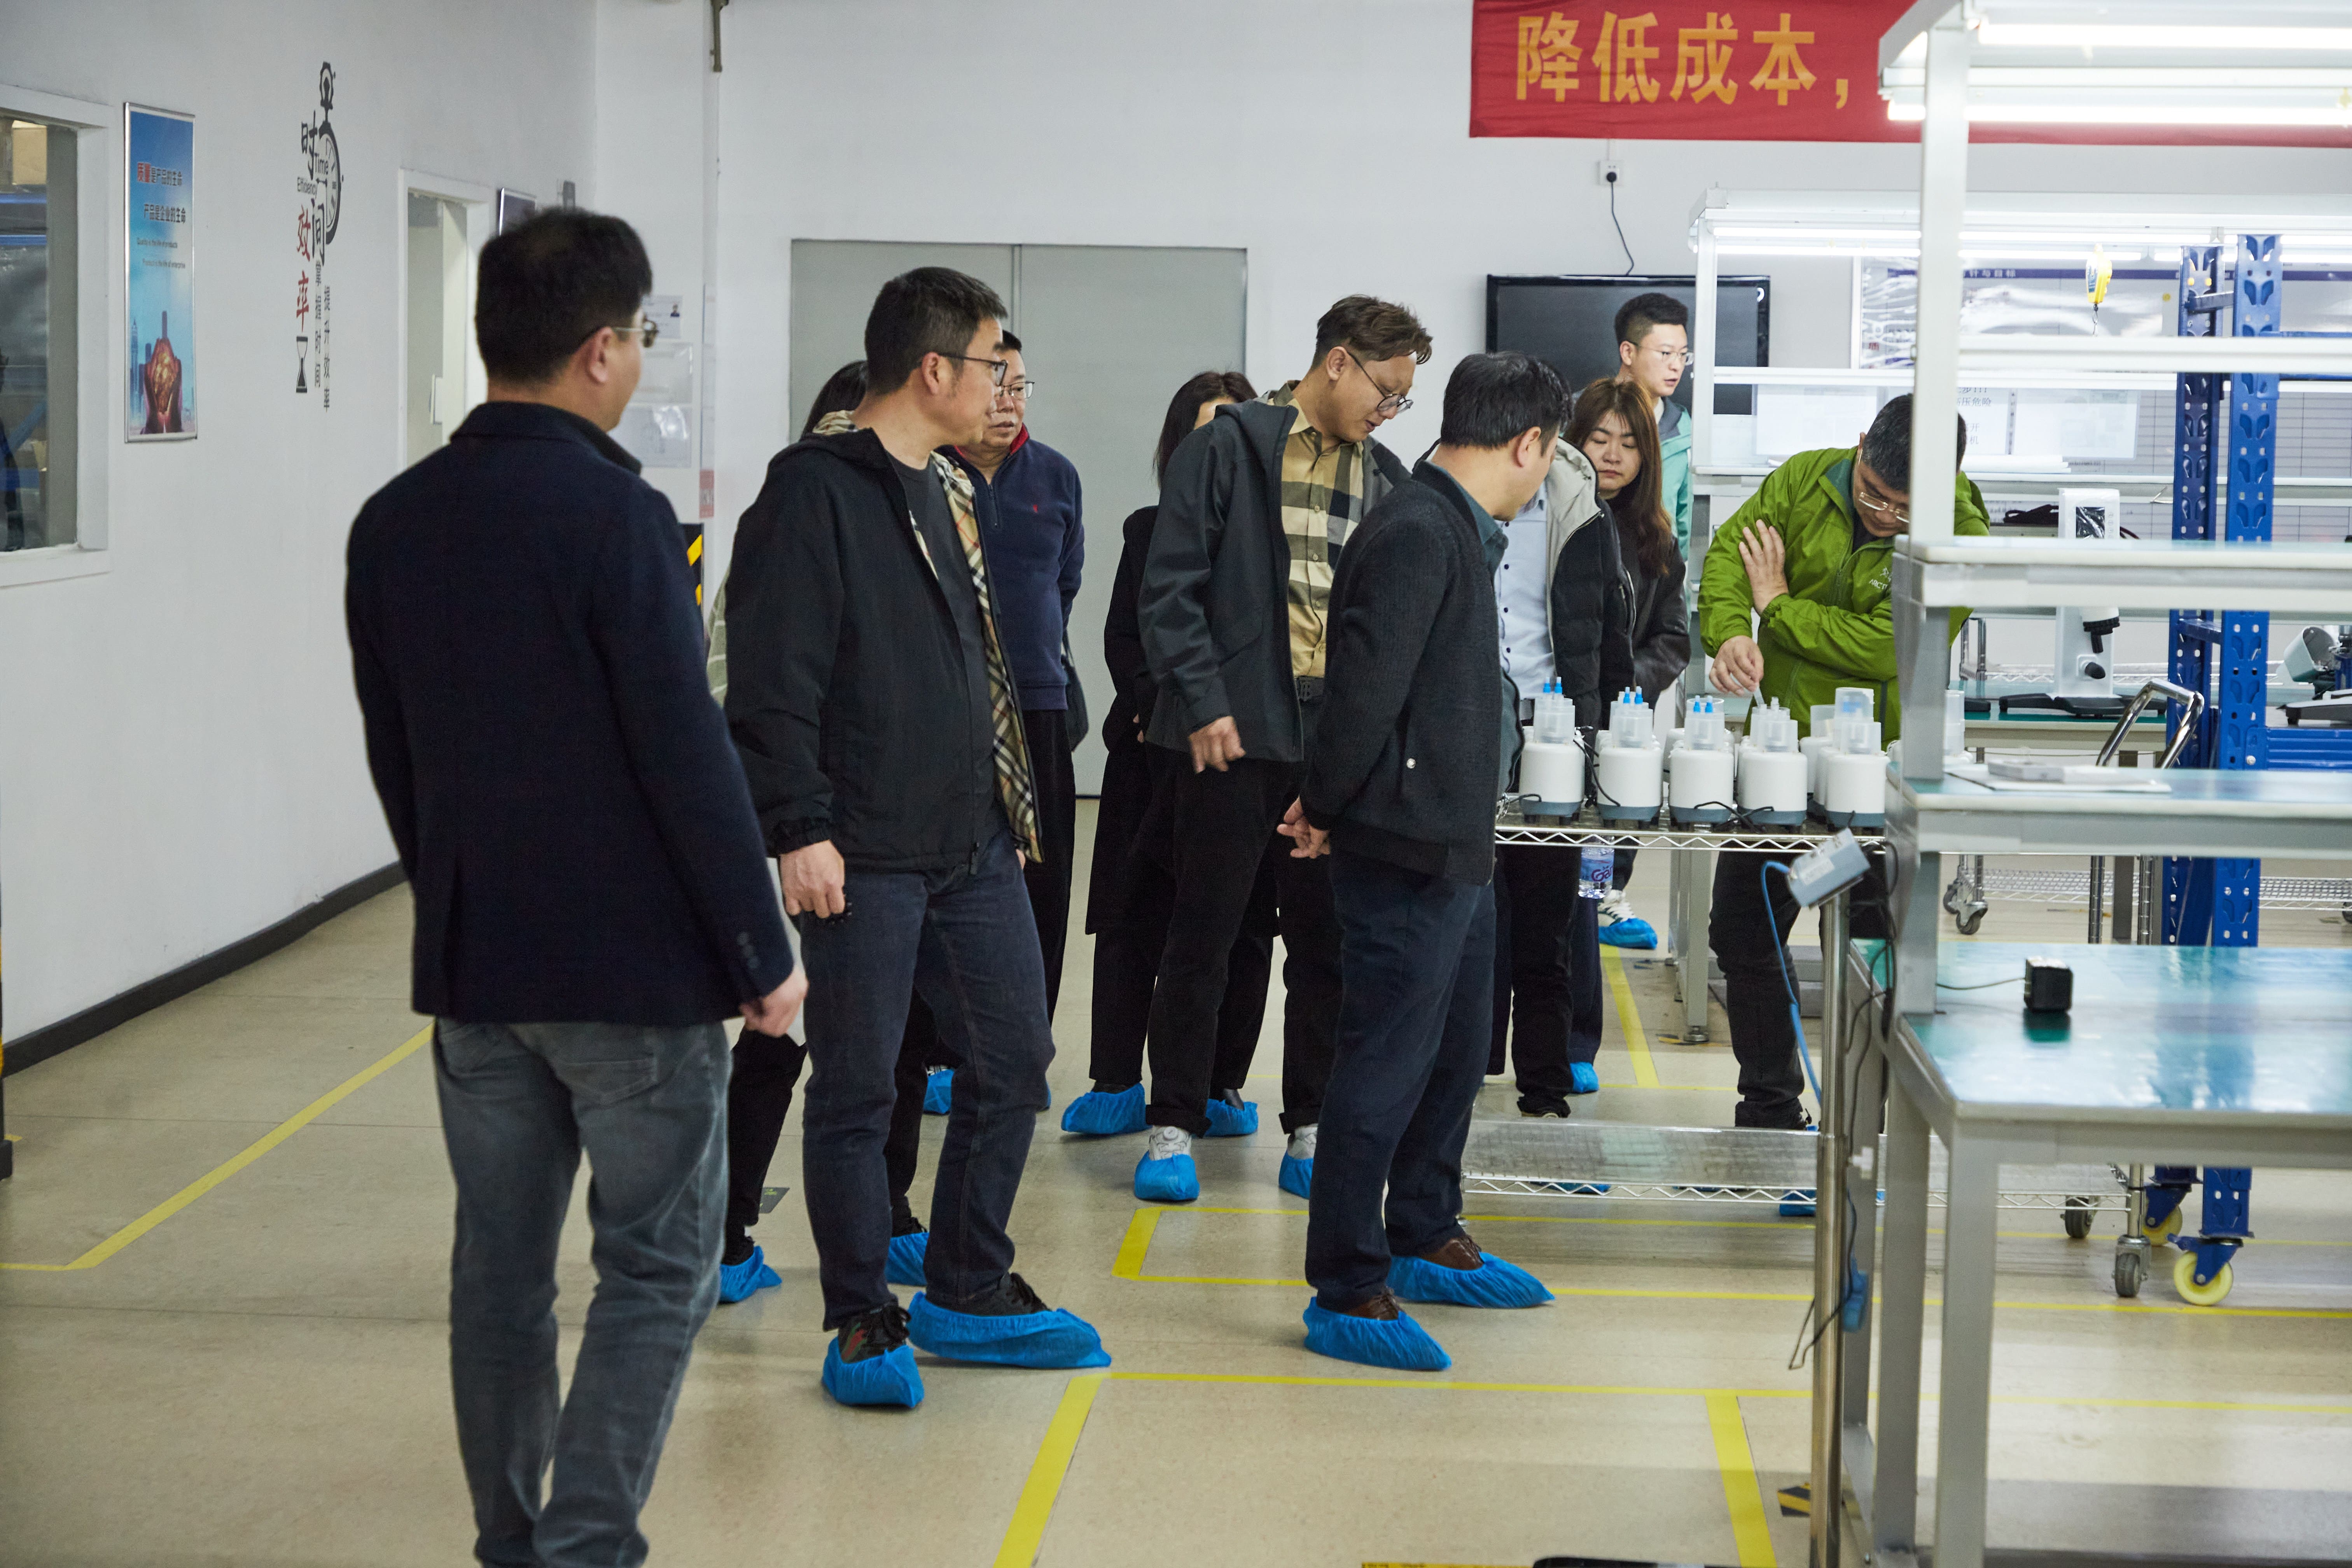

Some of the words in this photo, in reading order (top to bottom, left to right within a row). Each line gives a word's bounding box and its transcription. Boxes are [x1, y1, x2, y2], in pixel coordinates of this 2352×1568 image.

[1516, 11, 1849, 110] 降低成本，
[137, 162, 182, 186] 质量是产品的生命
[315, 152, 329, 175] Time
[297, 177, 318, 200] Efficiency
[144, 203, 185, 224] 产品是企业的生命
[1963, 269, 2016, 277] 针与目标
